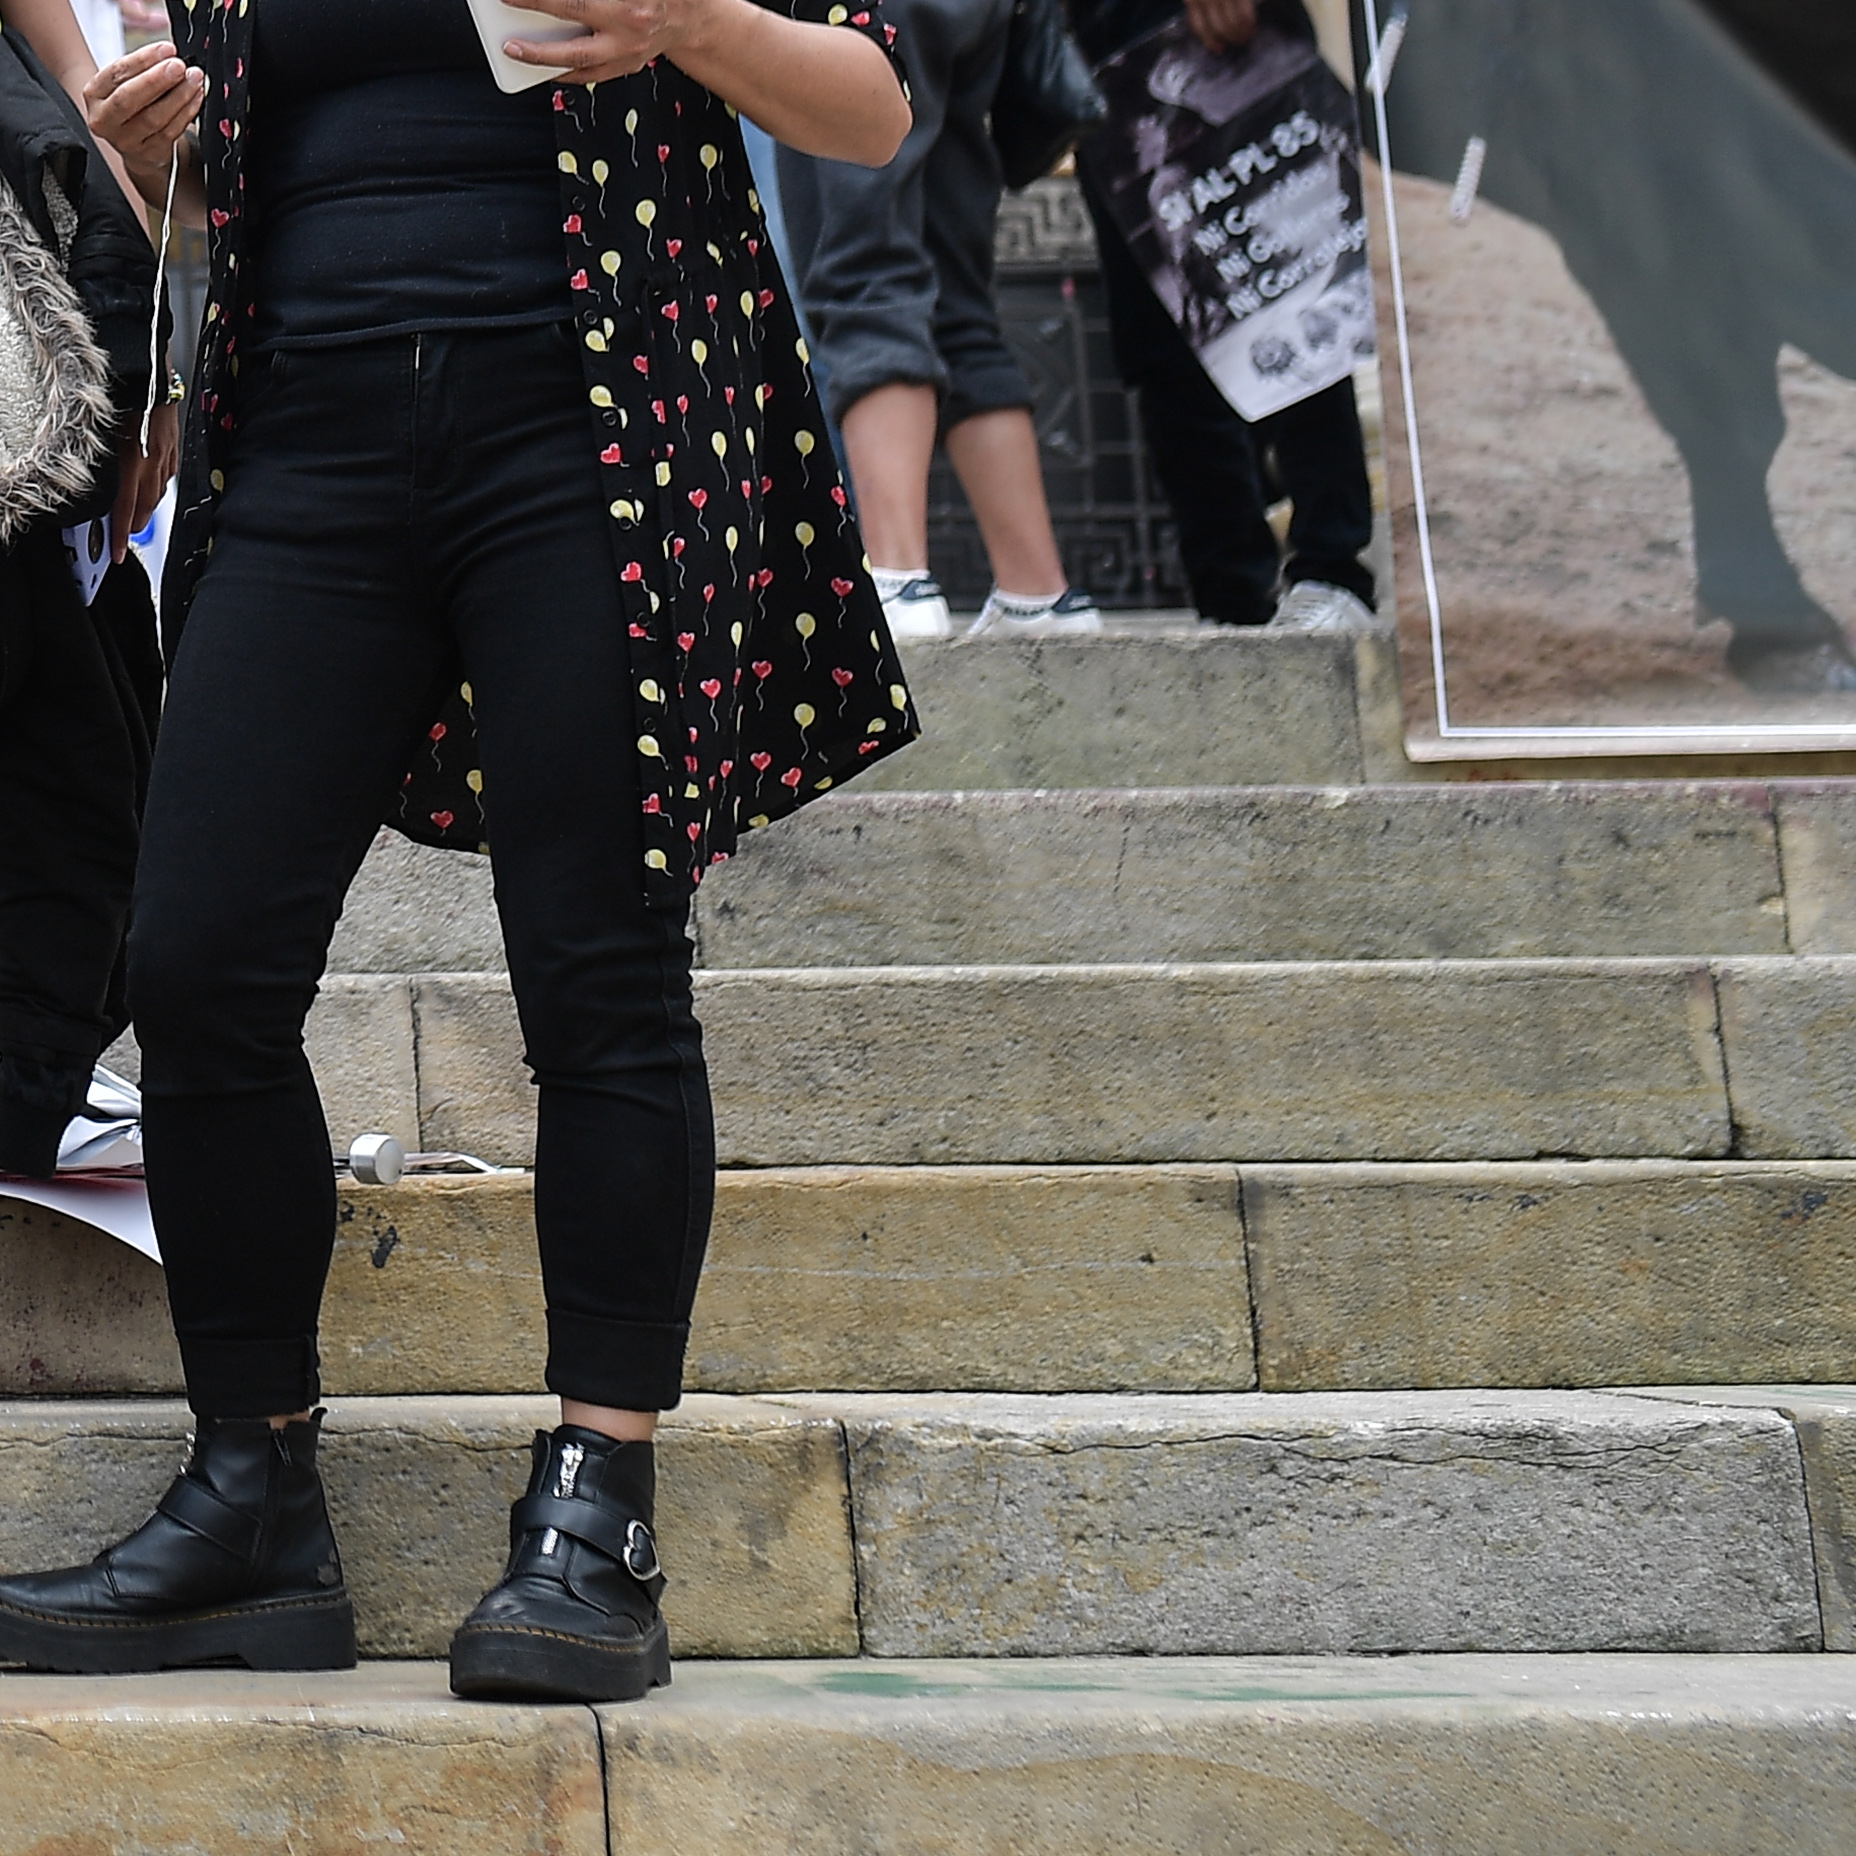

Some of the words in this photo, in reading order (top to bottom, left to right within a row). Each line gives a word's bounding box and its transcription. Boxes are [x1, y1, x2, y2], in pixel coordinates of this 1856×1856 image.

[1192, 168, 1238, 214] AL
[1229, 143, 1279, 185] PL
[1272, 110, 1319, 157] 85
[1258, 217, 1367, 298] Corraleja
